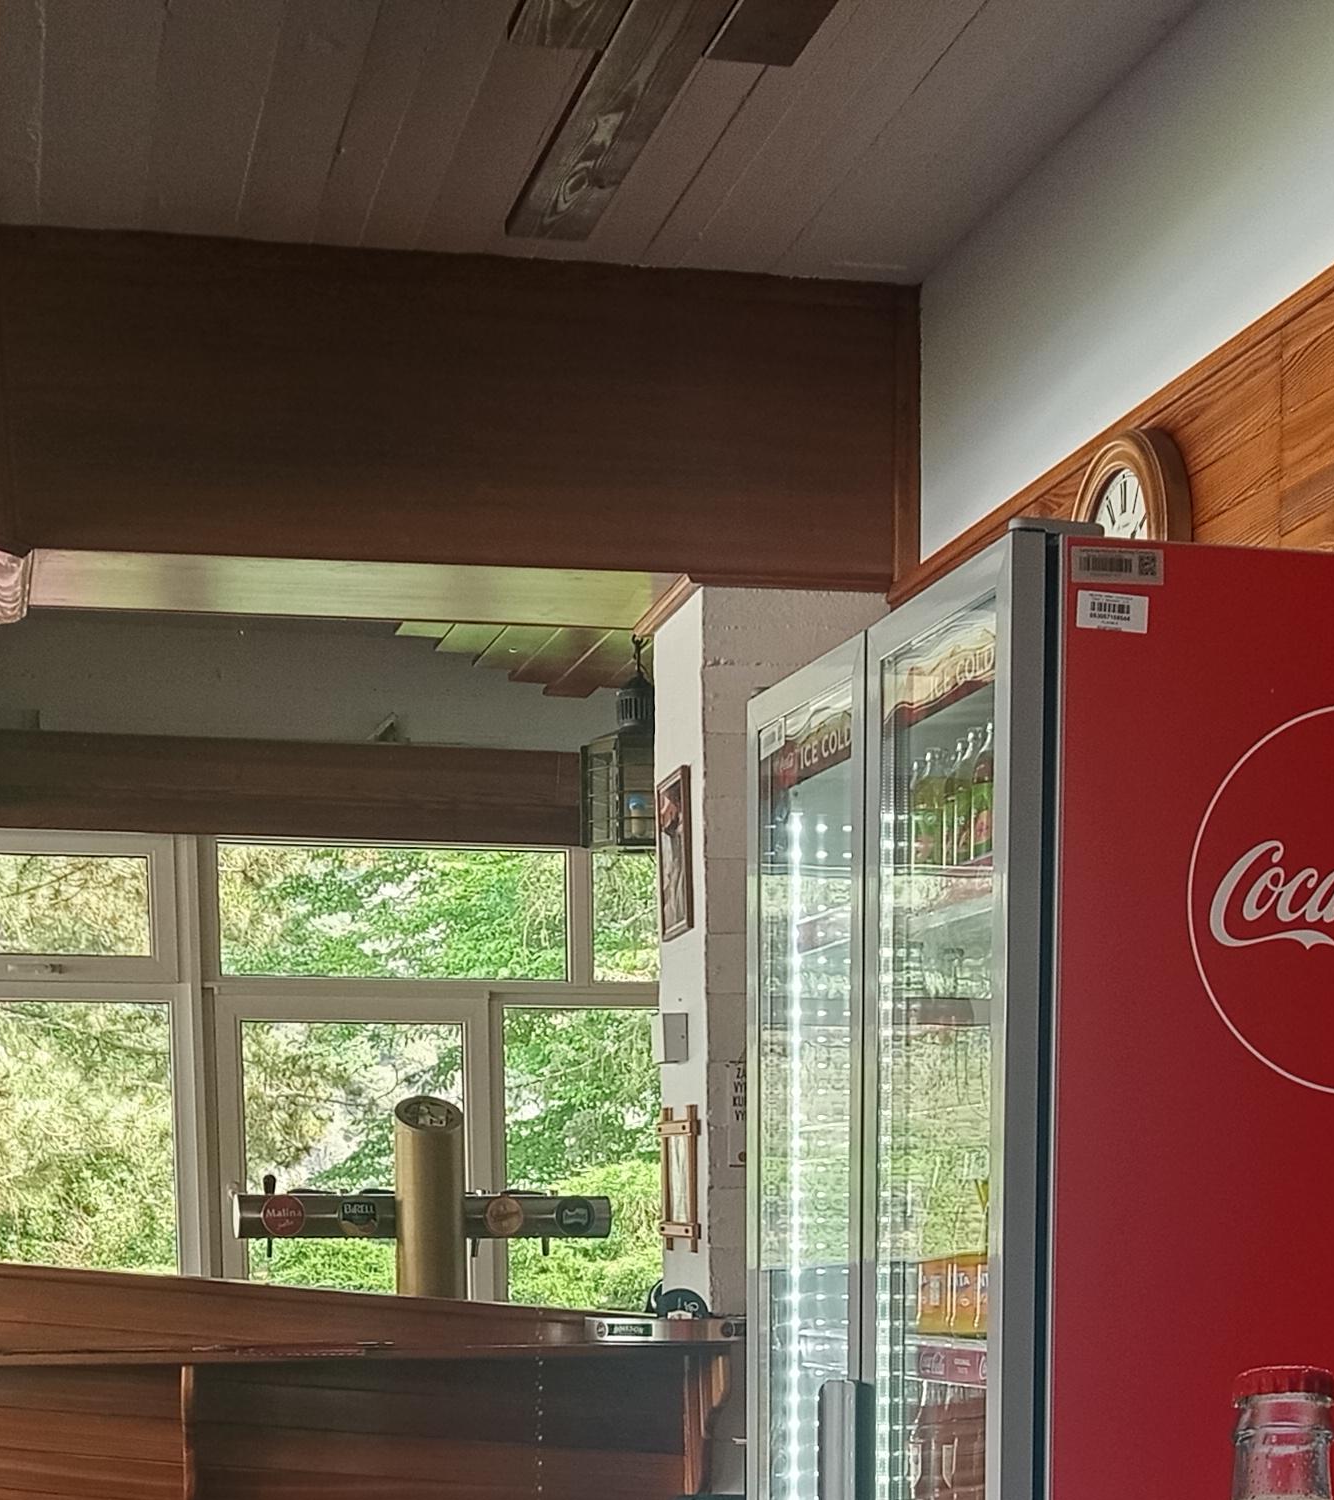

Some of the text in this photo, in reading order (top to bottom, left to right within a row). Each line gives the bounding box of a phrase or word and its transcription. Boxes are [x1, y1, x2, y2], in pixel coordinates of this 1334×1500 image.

[930, 676, 952, 699] ICE
[800, 728, 851, 769] ICE COLD
[266, 1208, 302, 1218] Malina
